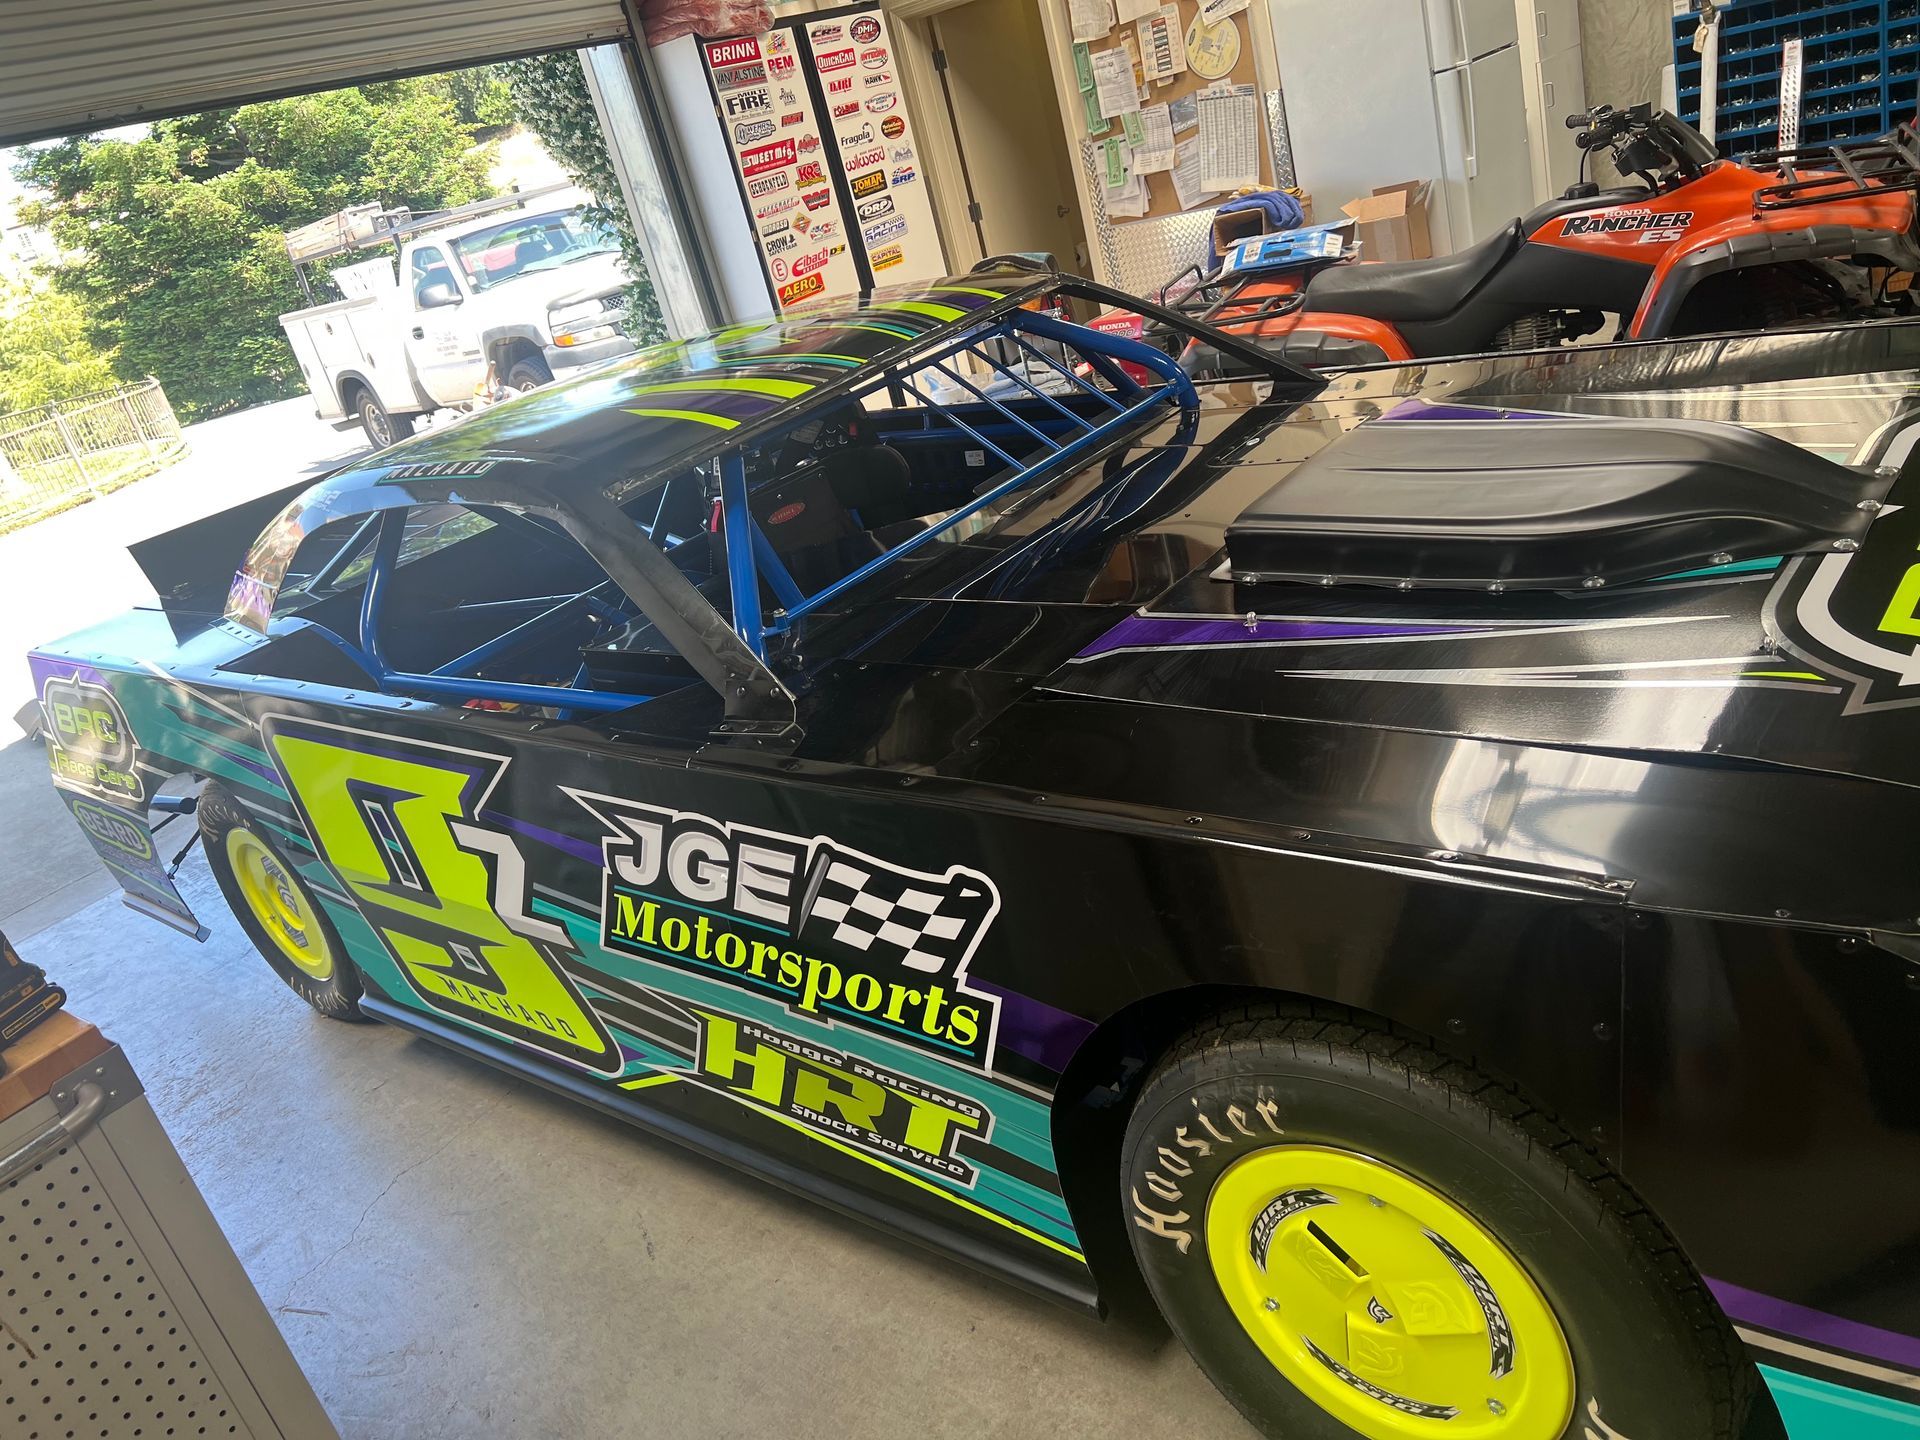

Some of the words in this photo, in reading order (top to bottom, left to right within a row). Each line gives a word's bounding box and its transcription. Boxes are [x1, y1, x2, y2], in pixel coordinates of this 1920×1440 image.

[857, 24, 873, 35] DMI
[712, 42, 755, 63] BRINN
[767, 55, 794, 71] PEM
[864, 75, 883, 86] HAWK
[738, 88, 767, 98] MULTI
[726, 94, 769, 116] FIRE
[841, 131, 870, 147] Fragola
[745, 151, 773, 167] SWEET
[853, 172, 883, 193] JOMAR
[892, 172, 916, 185] SRP
[864, 200, 888, 215] DRP
[1604, 208, 1652, 218] HONDA
[1560, 211, 1694, 237] RANCHER
[766, 235, 788, 252] CROW
[1638, 228, 1685, 244] ES
[792, 246, 828, 277] Eibach
[872, 249, 900, 262] CAPITAL
[784, 277, 816, 298] AERO
[1099, 322, 1131, 331] HONDA
[386, 460, 496, 479] MACHADO
[57, 752, 95, 779] Race
[95, 763, 136, 790] Cars
[78, 807, 144, 850] BEARD
[613, 814, 796, 925] JGE
[611, 893, 980, 1046] Motorsports
[436, 976, 578, 1040] MACHADO
[743, 1025, 843, 1067] Hogge
[854, 1063, 981, 1118] Racing
[689, 1008, 980, 1157] HRT
[791, 1103, 860, 1137] Shock
[867, 1131, 965, 1177] Service
[1133, 1096, 1285, 1254] Hoosier
[1254, 1195, 1296, 1242] DIRT
